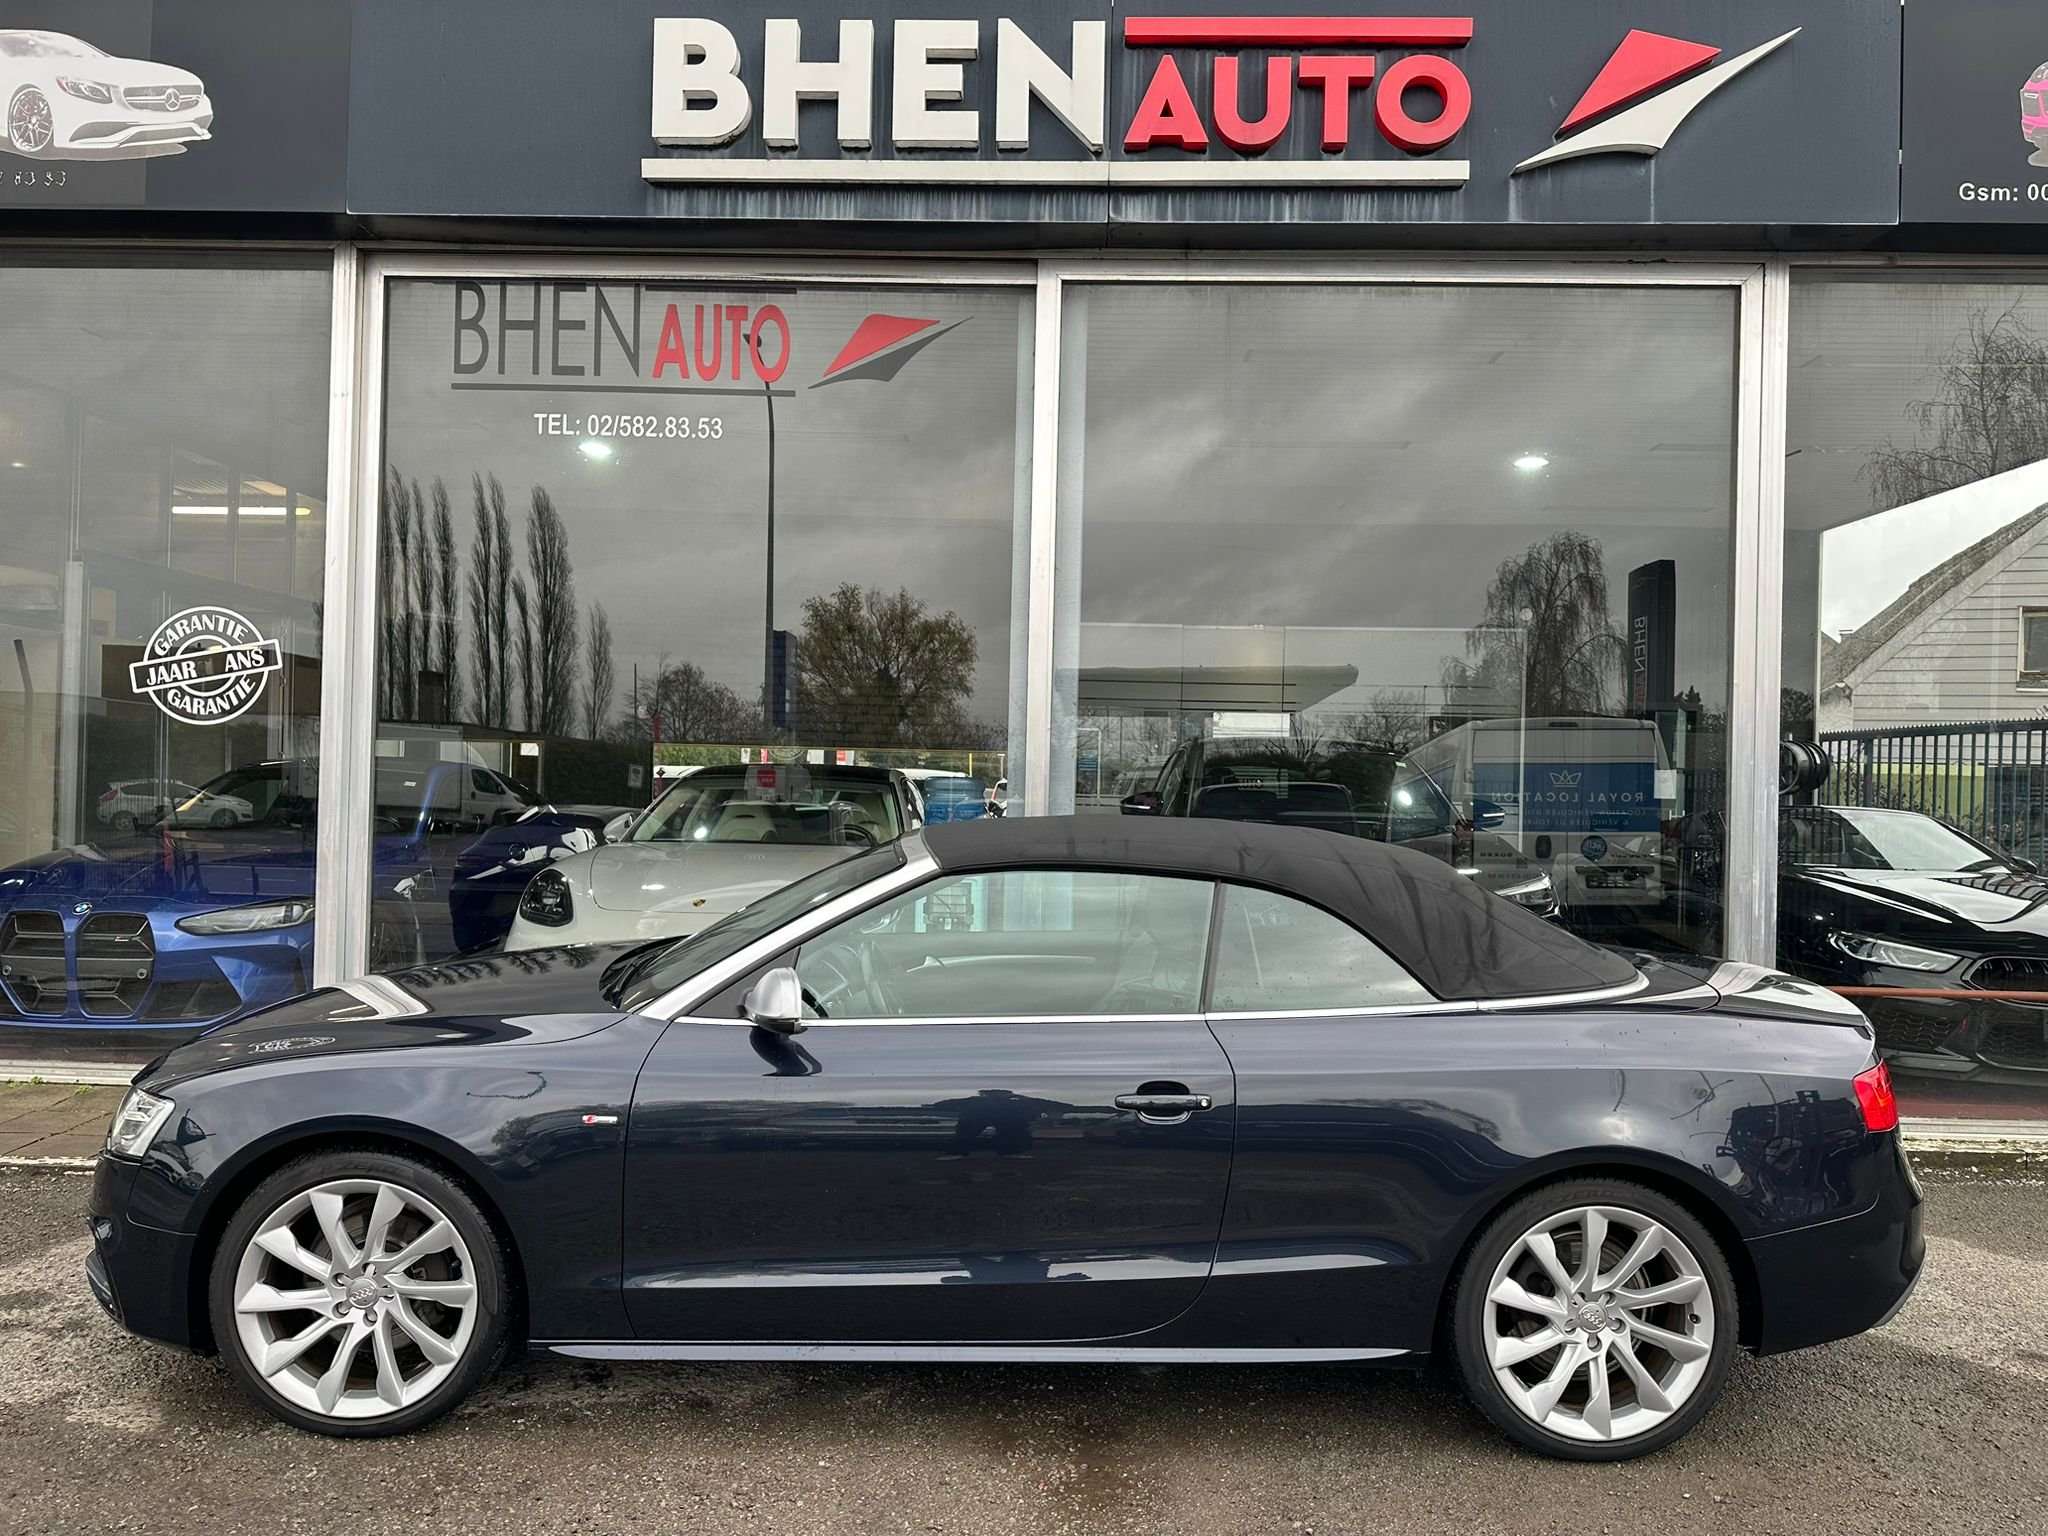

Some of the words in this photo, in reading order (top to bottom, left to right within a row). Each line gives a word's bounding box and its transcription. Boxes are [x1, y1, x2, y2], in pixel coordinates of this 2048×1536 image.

[652, 18, 1106, 153] BHEN
[1124, 54, 1472, 156] AUTO
[1959, 182, 2018, 201] Gsm:
[453, 279, 641, 378] BHEN
[652, 303, 791, 383] AUTO
[534, 413, 581, 435] TEL:
[587, 414, 723, 440] 02/582.83.53
[153, 613, 249, 657] GARANTIE
[147, 660, 198, 686] JAAR
[224, 646, 266, 673] ANS
[167, 673, 256, 716] GARANTIE
